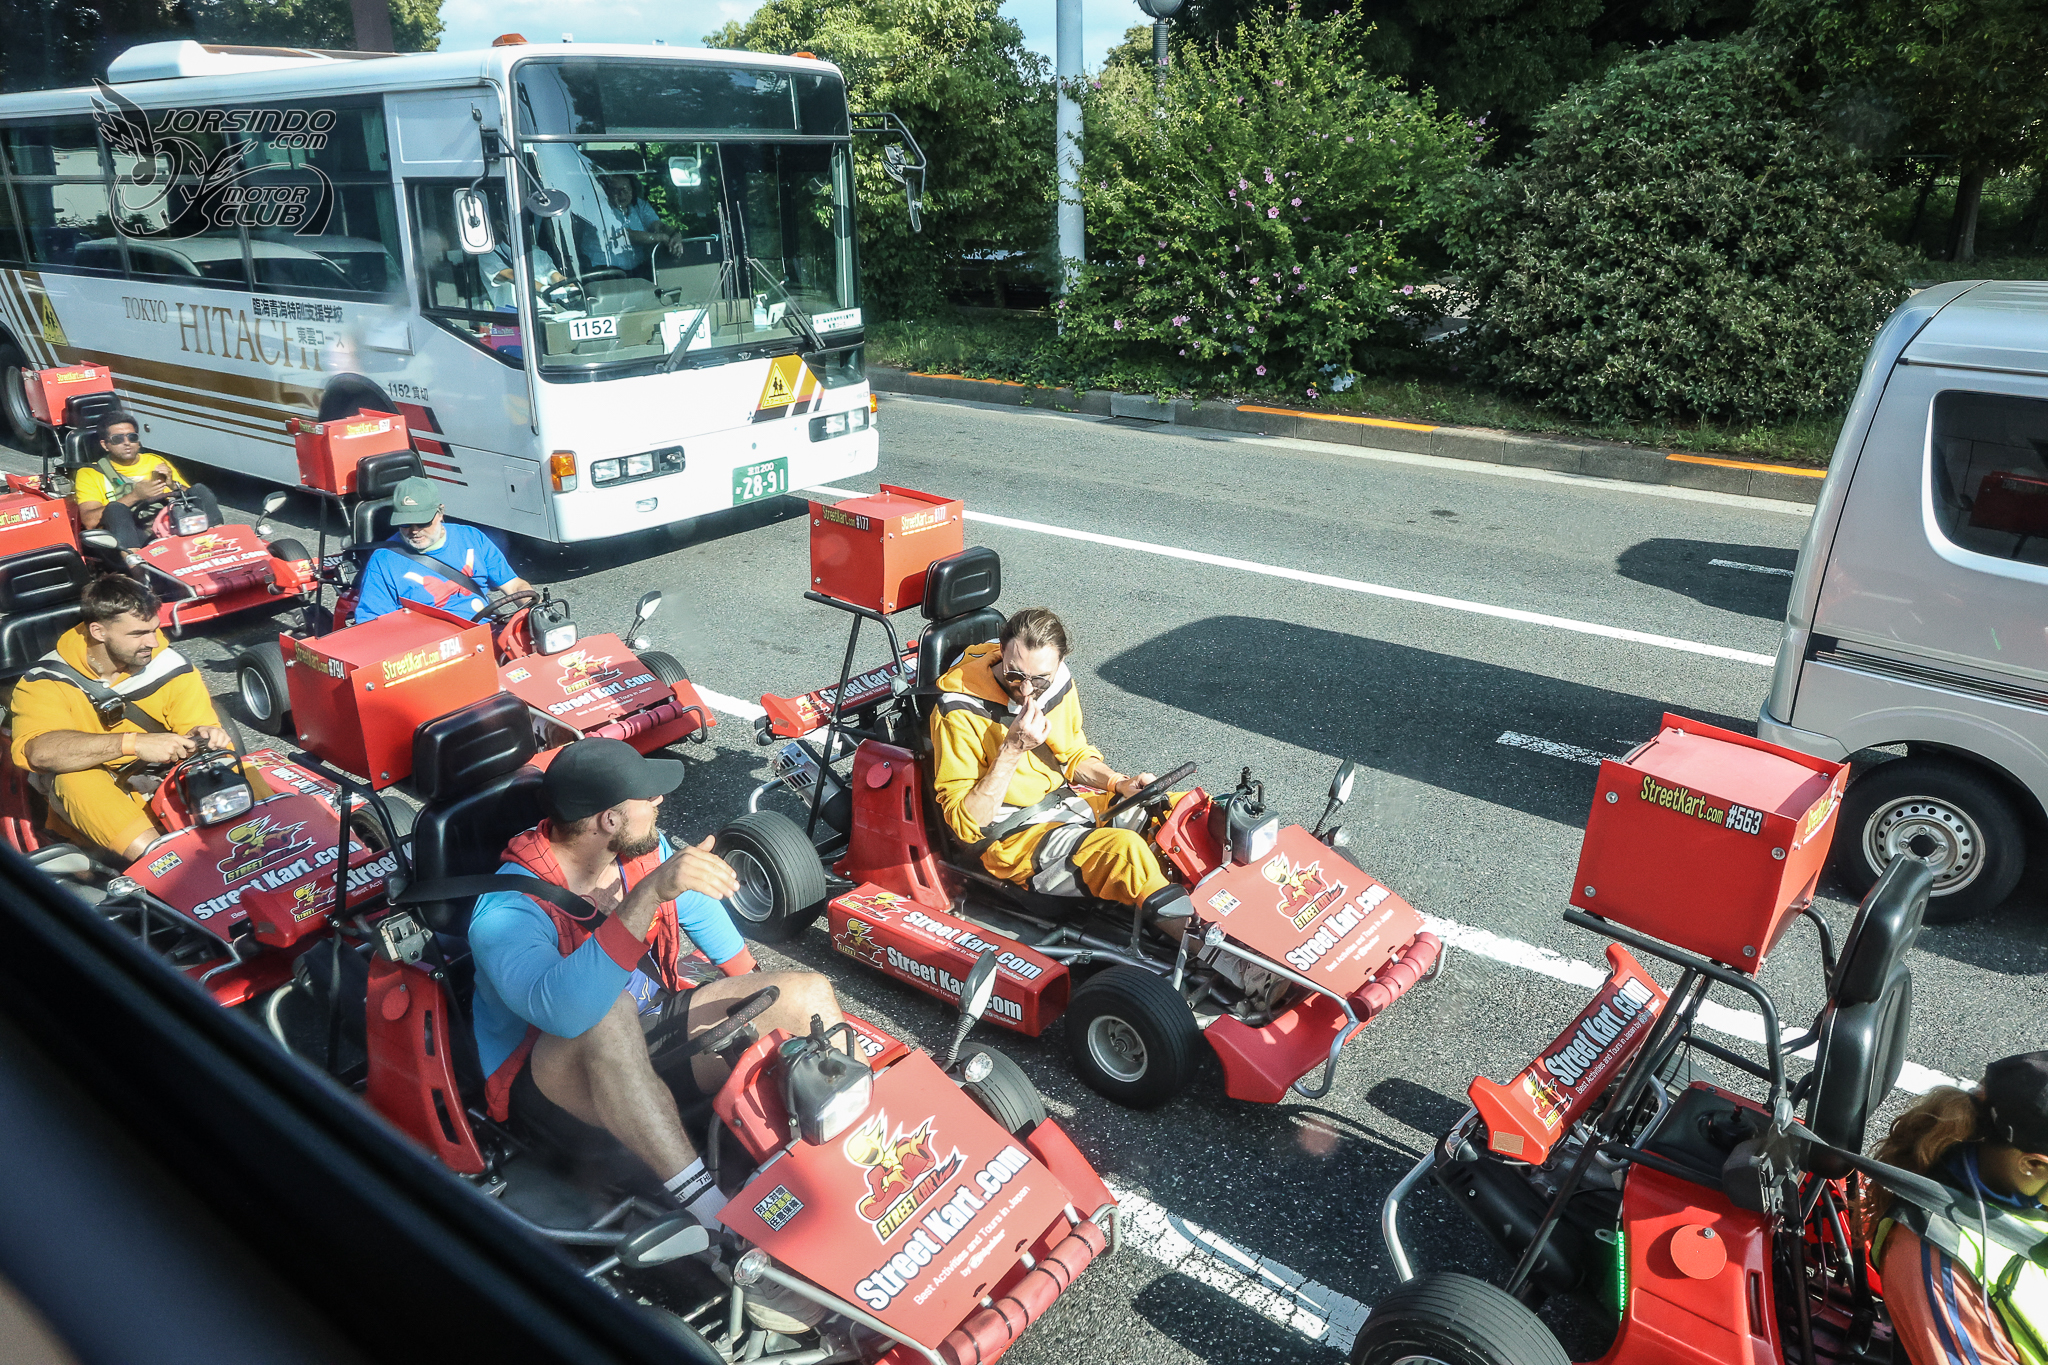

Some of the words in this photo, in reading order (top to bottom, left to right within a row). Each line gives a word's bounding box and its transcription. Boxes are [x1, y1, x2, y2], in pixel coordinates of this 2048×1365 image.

[121, 296, 168, 324] TOKYO
[573, 319, 613, 338] 1152
[388, 382, 411, 399] 1152
[412, 386, 429, 401] 貸切
[742, 468, 785, 500] 28-91
[855, 514, 869, 531] #177
[328, 658, 345, 680] #794
[382, 649, 440, 681] StreetKart.com
[859, 668, 891, 689] Kart
[547, 692, 595, 716] Street
[594, 681, 626, 700] Kart
[625, 673, 657, 689] .com
[1640, 775, 1725, 826] StreetKart.com
[1725, 804, 1764, 836] #563
[192, 880, 267, 921] Stret
[264, 858, 314, 891] Kart
[314, 839, 364, 869] .com
[1285, 925, 1340, 971] Street
[1323, 902, 1366, 939] Kart
[1355, 883, 1391, 916] .com
[1362, 923, 1377, 938] Tours
[1379, 907, 1394, 924] Japan
[902, 910, 961, 940] Street
[953, 929, 1000, 955] Kart
[994, 951, 1043, 981] .com
[886, 945, 938, 986] Street
[939, 968, 965, 996] Ka
[1544, 1026, 1604, 1087] Street
[1581, 1003, 1627, 1048] Kart
[1612, 976, 1655, 1020] .com
[1575, 1080, 1589, 1094] Best
[1586, 1061, 1606, 1084] Activities
[1603, 1053, 1613, 1066] and
[1608, 1041, 1623, 1060] Tours
[1619, 1037, 1627, 1047] in
[1624, 1025, 1637, 1042] Japan
[1634, 1021, 1642, 1032] by
[877, 1169, 943, 1240] STREETKART
[854, 1226, 944, 1311] Street
[920, 1183, 987, 1246] Kart
[974, 1144, 1032, 1202] .com
[913, 1283, 936, 1306] Best
[933, 1249, 969, 1287] Activities
[966, 1238, 982, 1254] and
[978, 1214, 1003, 1241] Tours
[999, 1206, 1010, 1217] in
[1008, 1185, 1031, 1209] Japan
[960, 1266, 972, 1278] by
